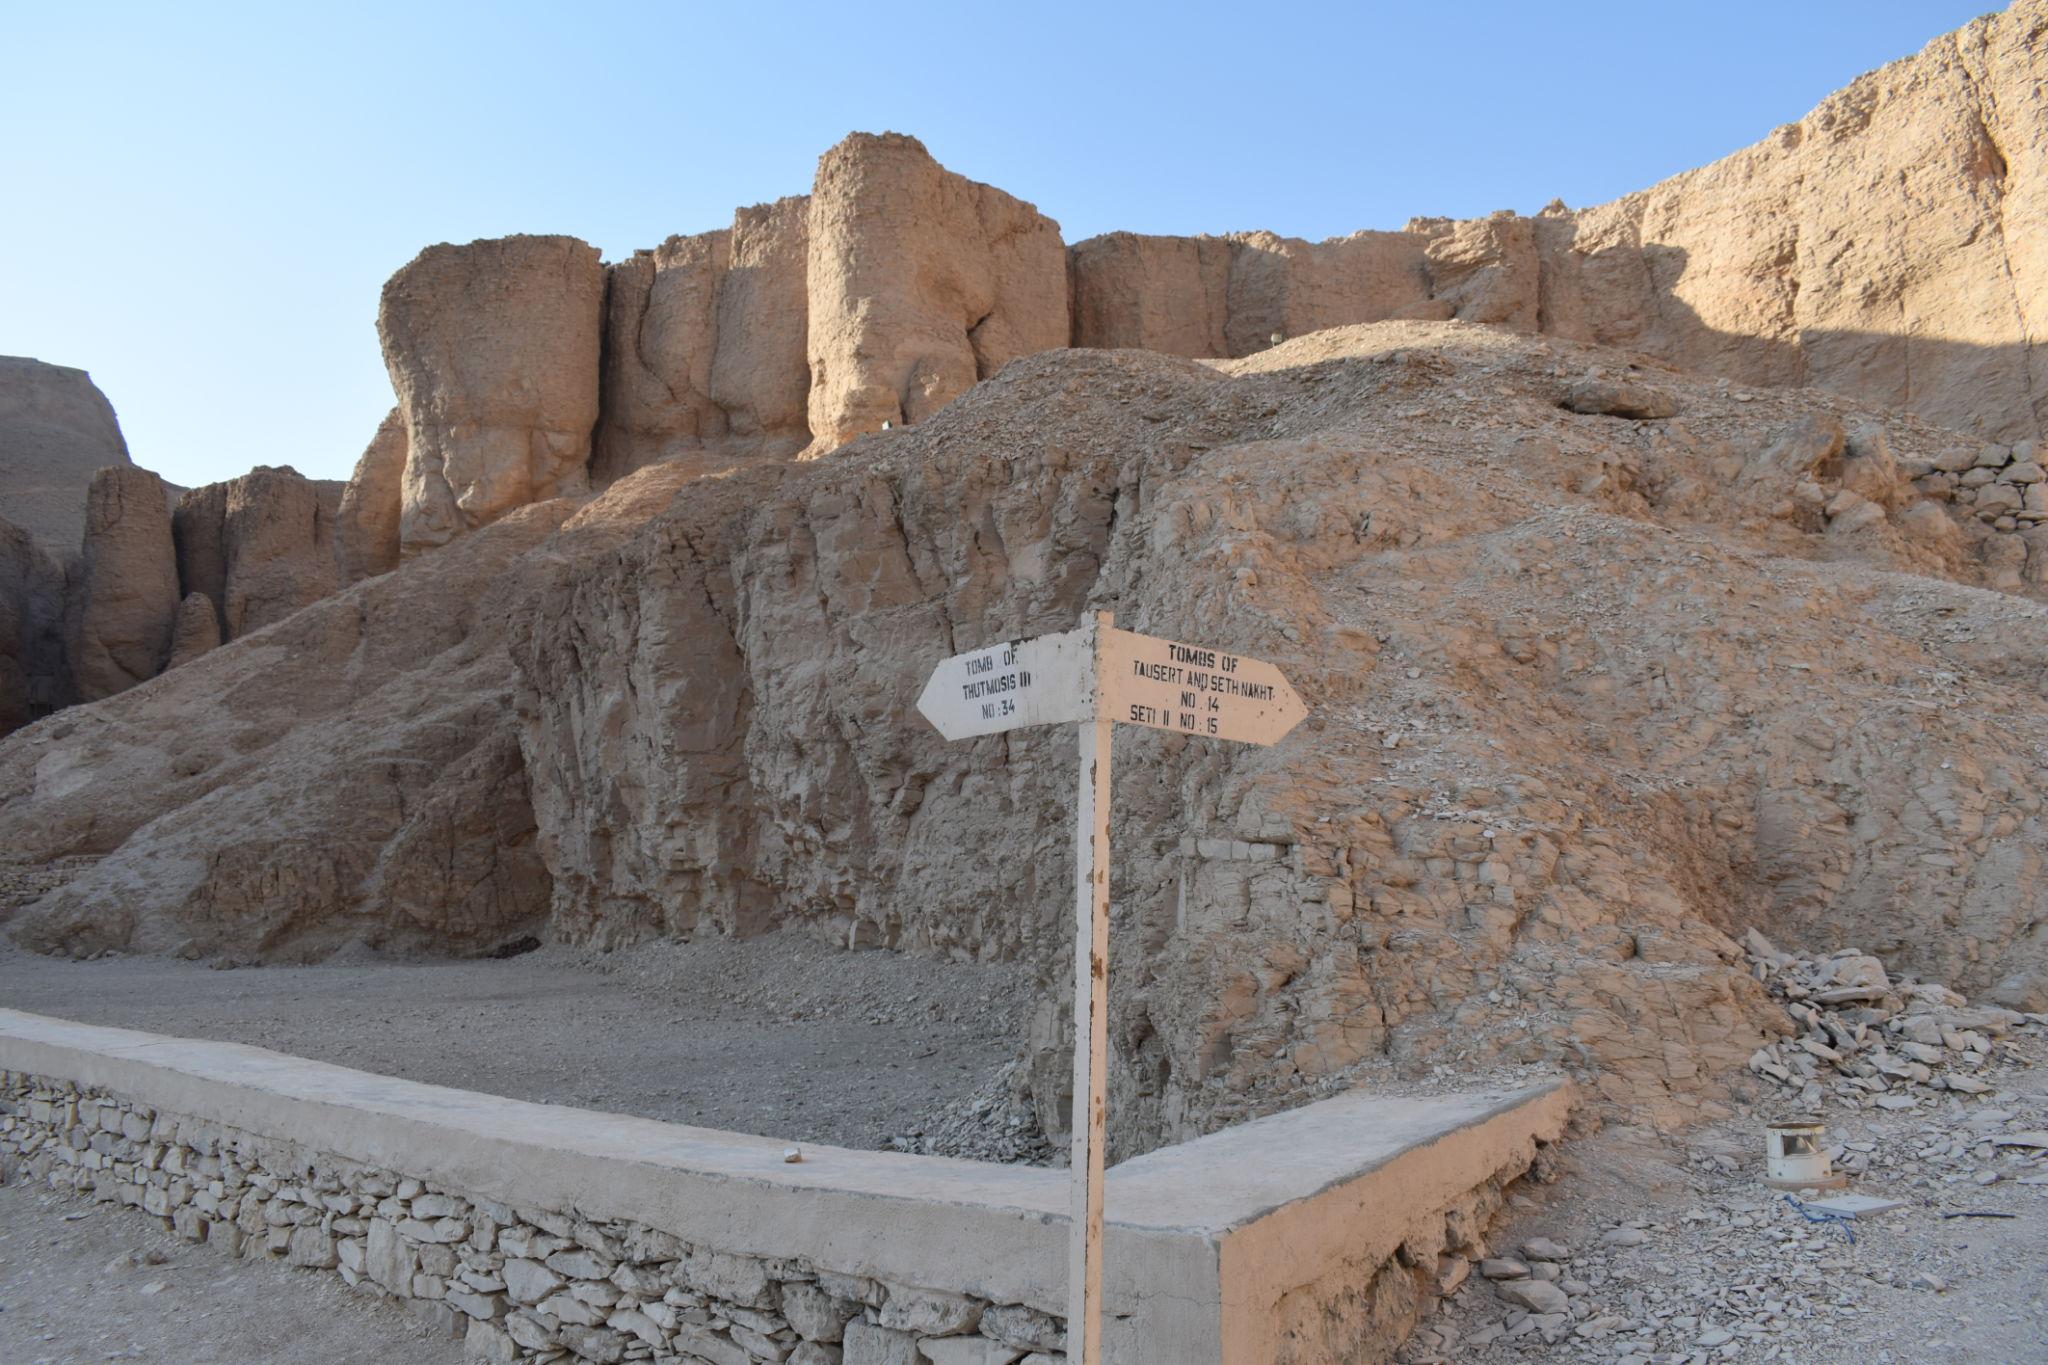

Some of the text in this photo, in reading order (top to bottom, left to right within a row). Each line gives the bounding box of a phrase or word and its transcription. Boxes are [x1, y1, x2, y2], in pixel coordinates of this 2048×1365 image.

[965, 655, 993, 676] TOMB
[1169, 644, 1238, 673] TOMBS OF
[962, 671, 1031, 700] THUTMOSIS III
[1133, 660, 1183, 685] TAUSERT
[1187, 670, 1208, 691] AND
[1207, 695, 1219, 712] 14
[1130, 704, 1156, 725] SETI
[1163, 709, 1170, 727] II
[1206, 717, 1218, 734] 15
